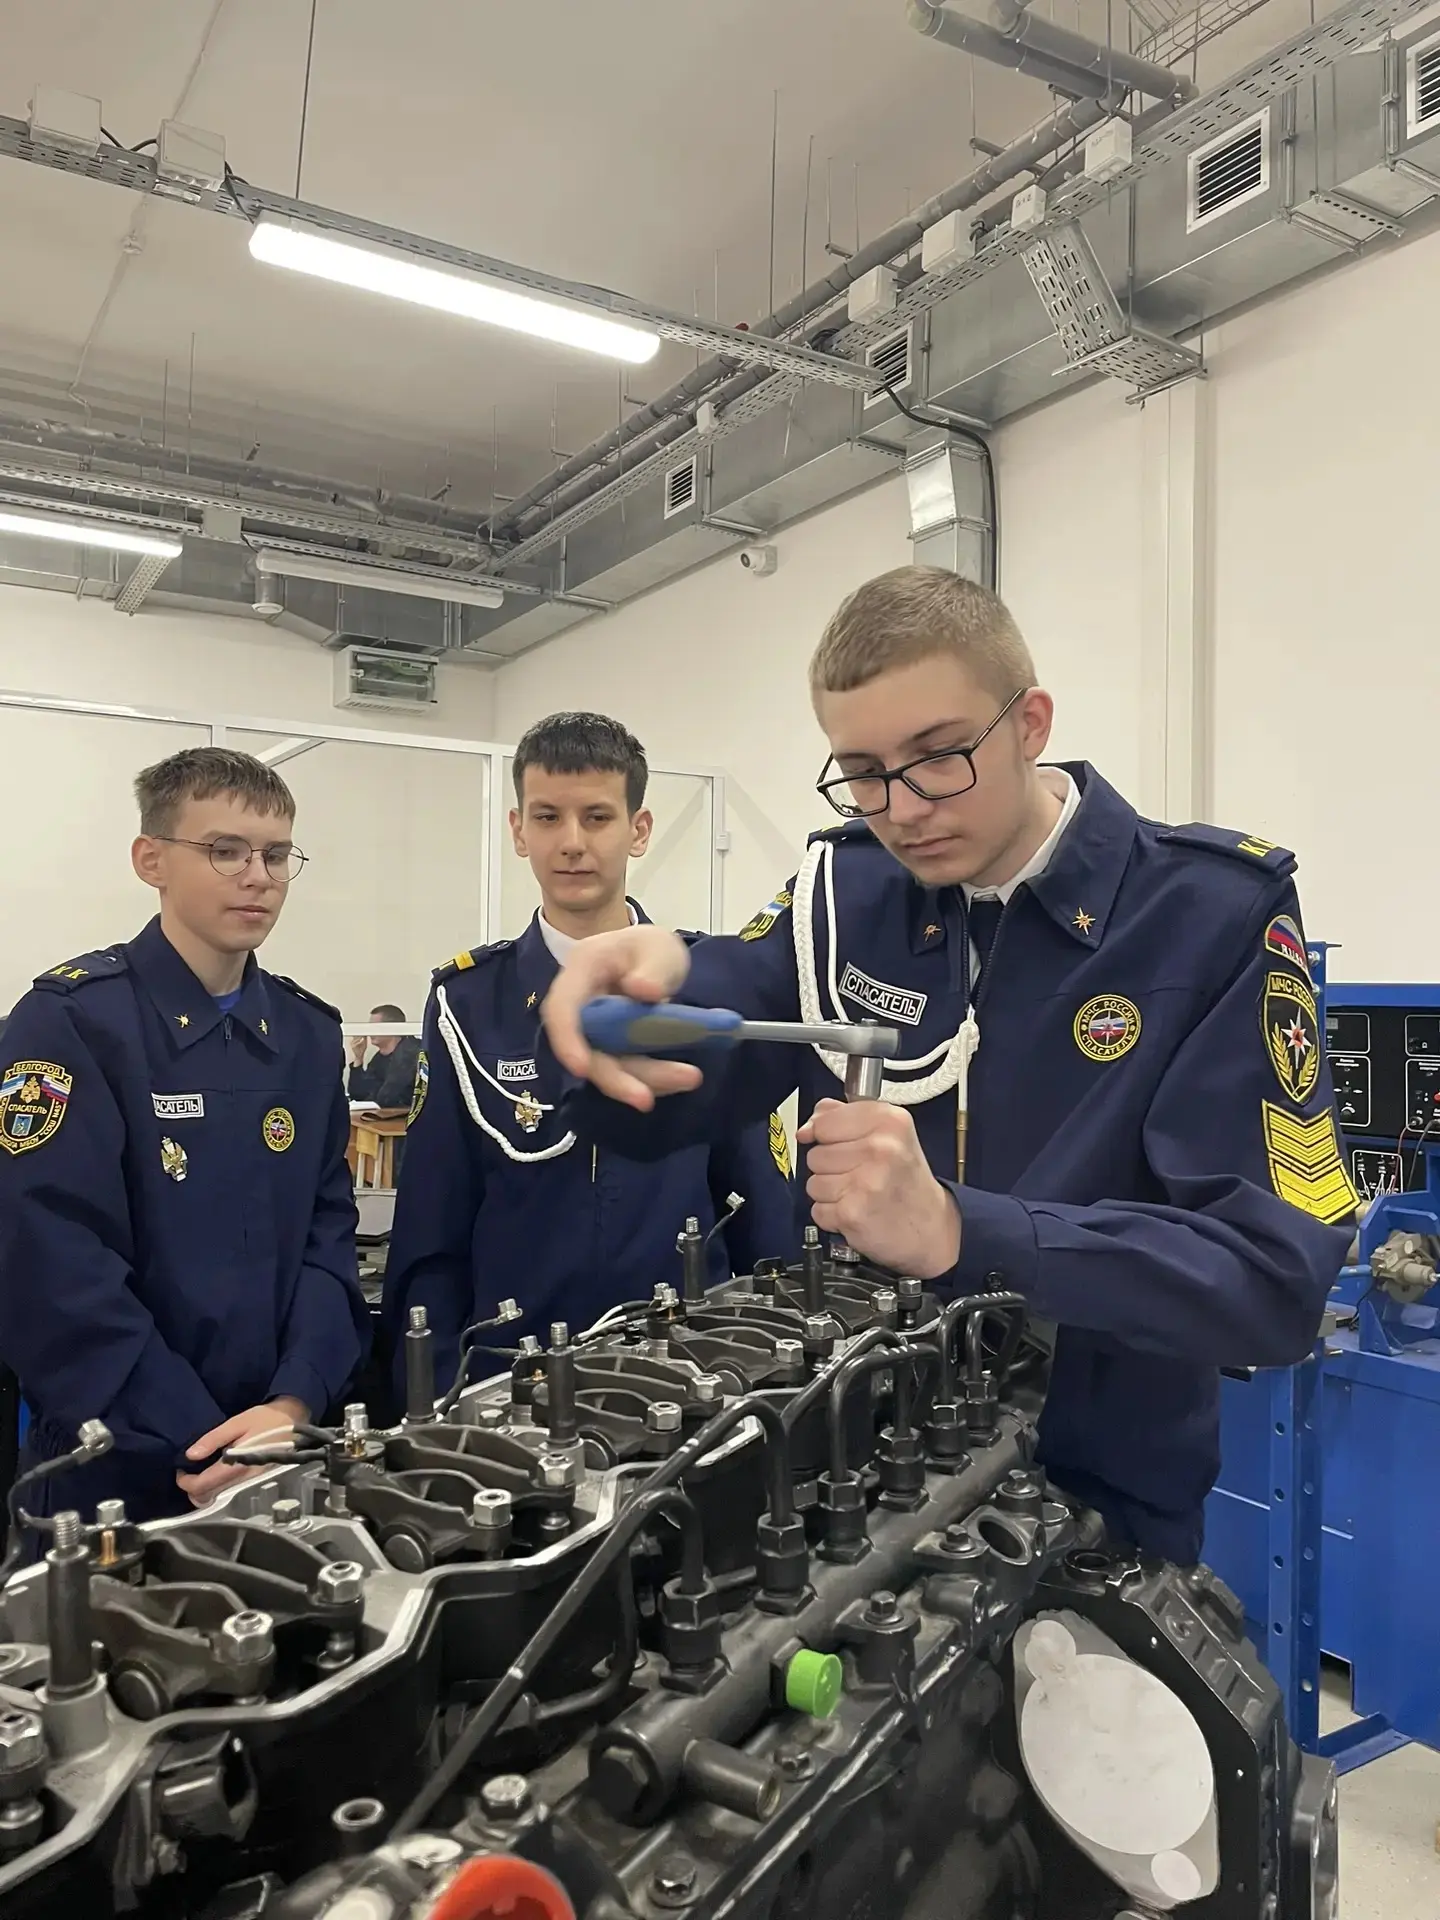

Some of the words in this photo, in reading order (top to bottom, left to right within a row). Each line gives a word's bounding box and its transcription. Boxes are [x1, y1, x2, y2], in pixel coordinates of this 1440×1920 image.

[1271, 976, 1293, 994] МЧС
[846, 974, 917, 1017] СПАСАТЕЛЬ
[1082, 1005, 1100, 1024] МЧС
[1103, 1000, 1136, 1025] РОССИИ
[1081, 1034, 1133, 1056] СПАСАТЕЛЬ
[15, 1063, 61, 1077] БЕЛГОРОД
[8, 1104, 48, 1115] СПАСАТЕЛЬ
